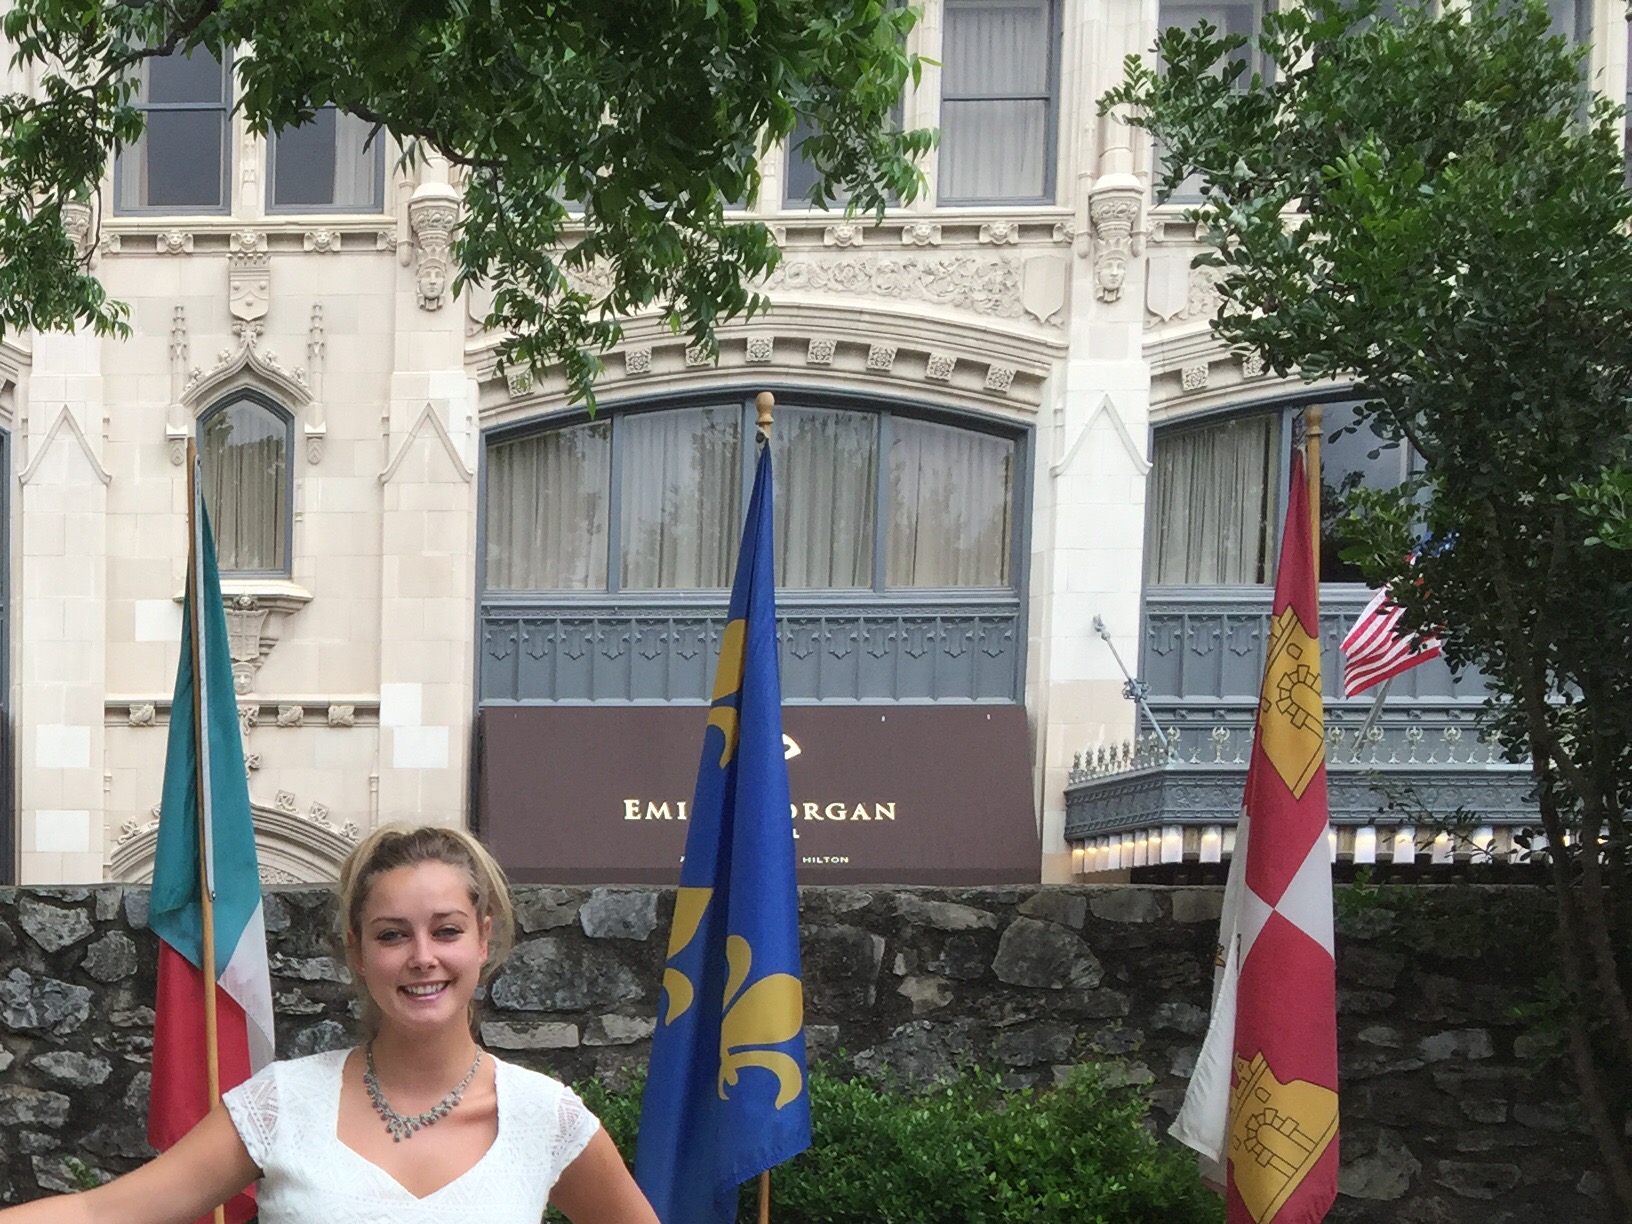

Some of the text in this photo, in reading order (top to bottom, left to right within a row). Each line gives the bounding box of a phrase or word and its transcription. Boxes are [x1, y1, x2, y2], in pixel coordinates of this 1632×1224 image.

[623, 799, 896, 821] EMI RGAN
[802, 856, 850, 864] HILTON
